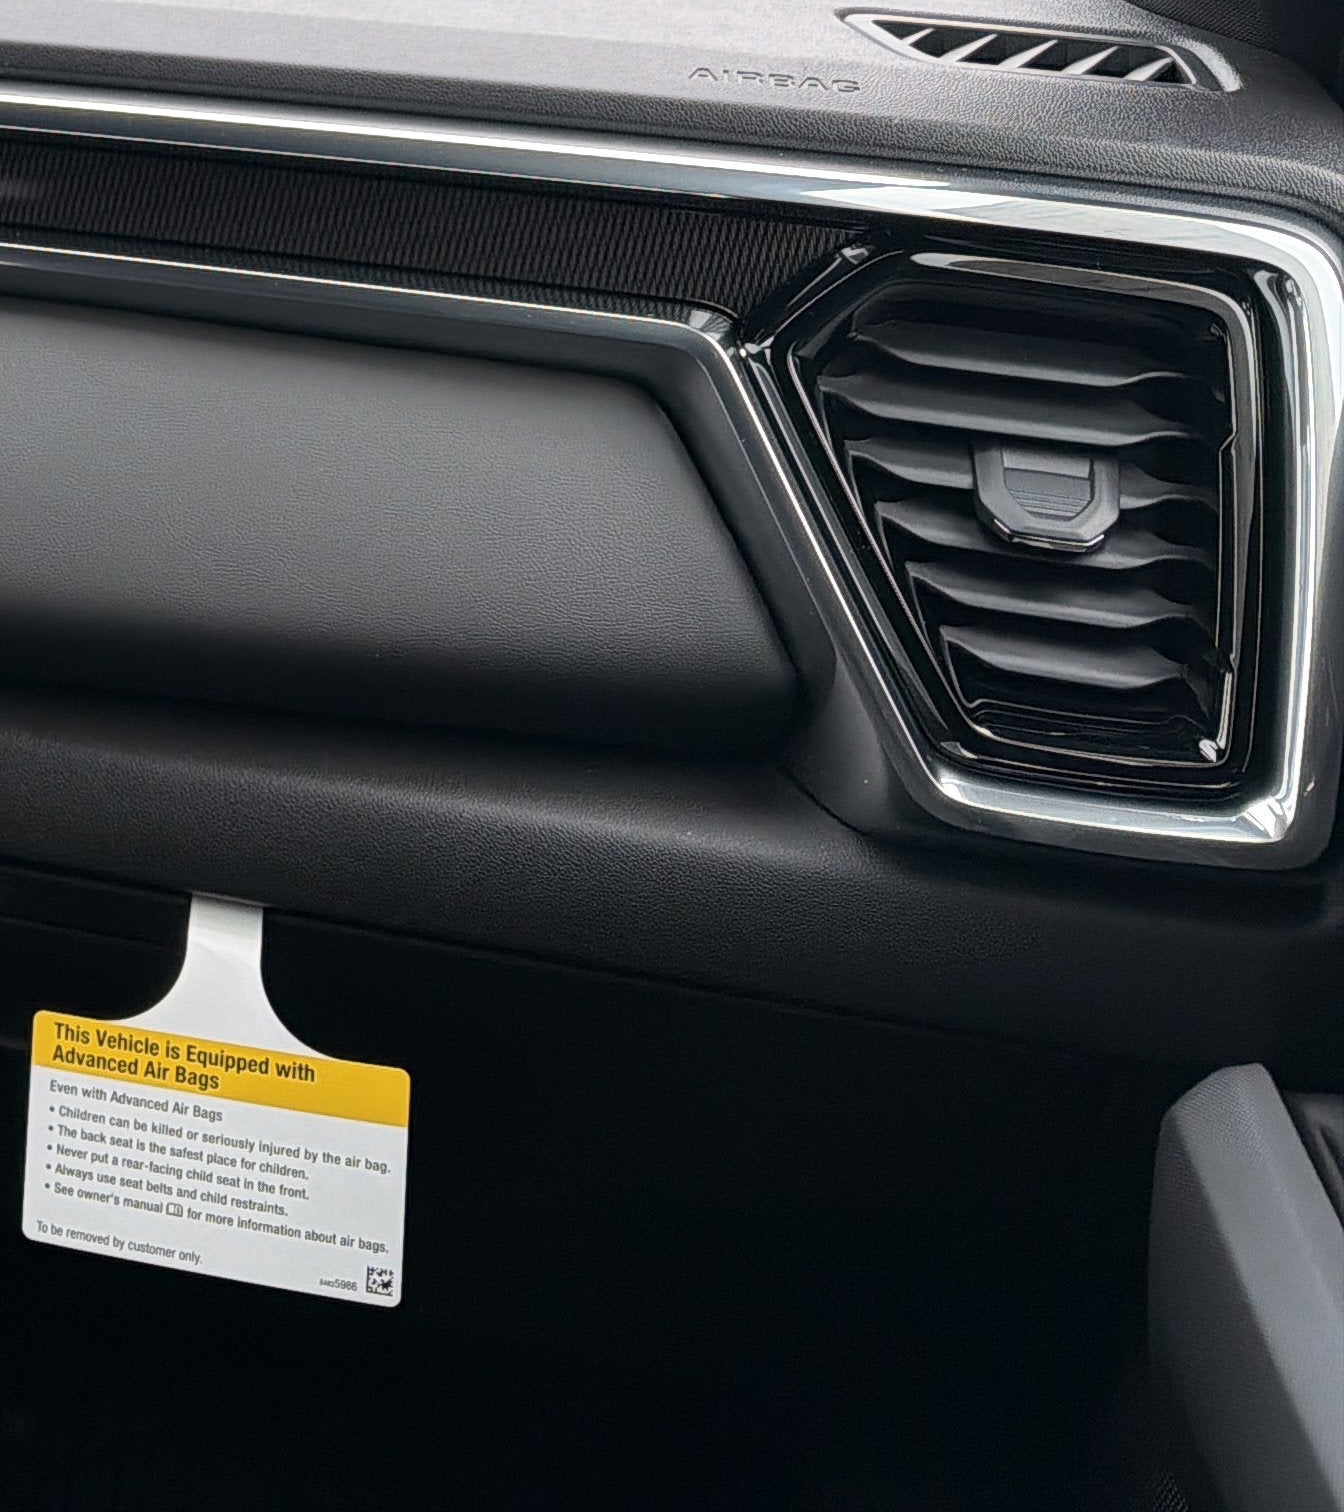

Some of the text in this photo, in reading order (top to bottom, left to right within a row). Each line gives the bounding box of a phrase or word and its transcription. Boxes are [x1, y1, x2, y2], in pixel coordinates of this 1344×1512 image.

[688, 67, 860, 92] AIRBAG
[52, 1045, 220, 1091] Advanced Air Bags
[54, 1022, 315, 1082] This Vehicle is Equipped with
[50, 1079, 223, 1123] Even with Advanced Air Bags
[57, 1124, 309, 1180] The back seat is the safest place for children.
[59, 1105, 391, 1174] Children can be killed or seriously injured by the air bag.
[55, 1162, 288, 1216] Always use seat belts and child restraints.
[56, 1143, 309, 1200] Never put a rear-facing child seat in the front.
[36, 1220, 203, 1266] To be removed by customer only.
[54, 1182, 389, 1254] See owner's manual for more information about air bags.
